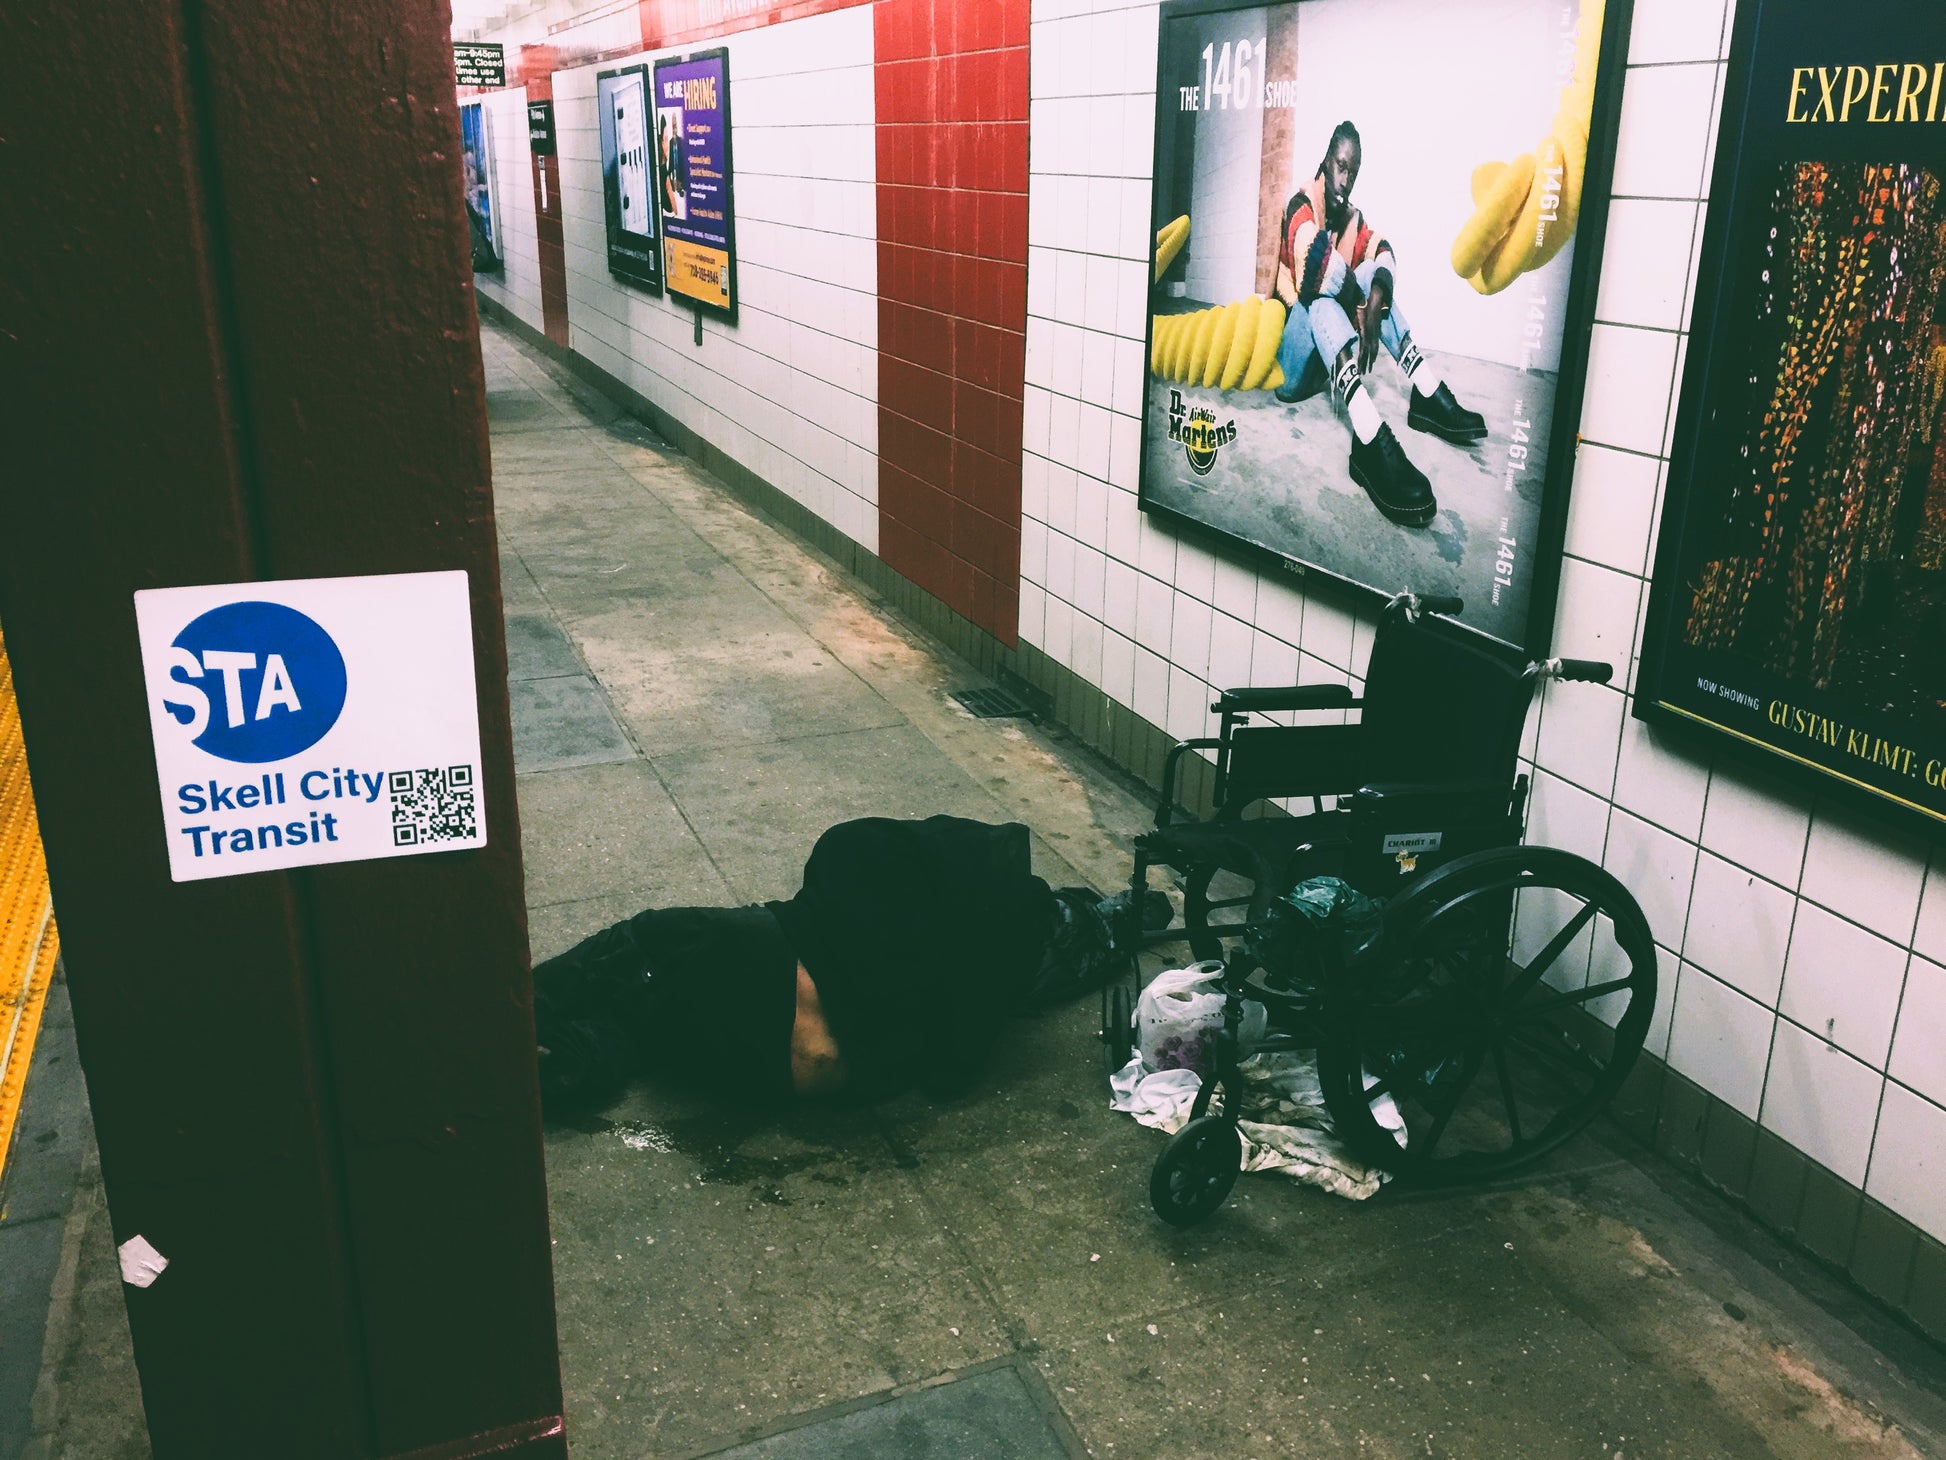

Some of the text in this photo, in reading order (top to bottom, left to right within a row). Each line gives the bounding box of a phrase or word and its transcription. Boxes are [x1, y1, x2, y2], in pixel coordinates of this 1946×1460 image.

[461, 76, 482, 84] other
[484, 76, 500, 85] end
[475, 58, 503, 67] Closed
[1180, 37, 1298, 111] THE 1461 SHOE
[663, 75, 717, 110] WE ARE HIRING
[1786, 62, 1946, 122] EXPERI
[1538, 165, 1563, 222] 1461
[1535, 222, 1545, 247] SHOE
[1522, 296, 1547, 350] 1461
[1168, 414, 1237, 450] Martens
[1504, 400, 1531, 492] THE 1461 SHOE
[1491, 517, 1517, 607] THE 1461 SHOE
[162, 646, 302, 742] STA
[1697, 677, 1760, 710] NOW SHOWING
[1768, 700, 1843, 747] GUSTAV
[1847, 728, 1918, 778] KLIMT:
[178, 768, 385, 815] Skell City
[181, 812, 339, 857] Transit
[1388, 838, 1426, 848] CHARIOT
